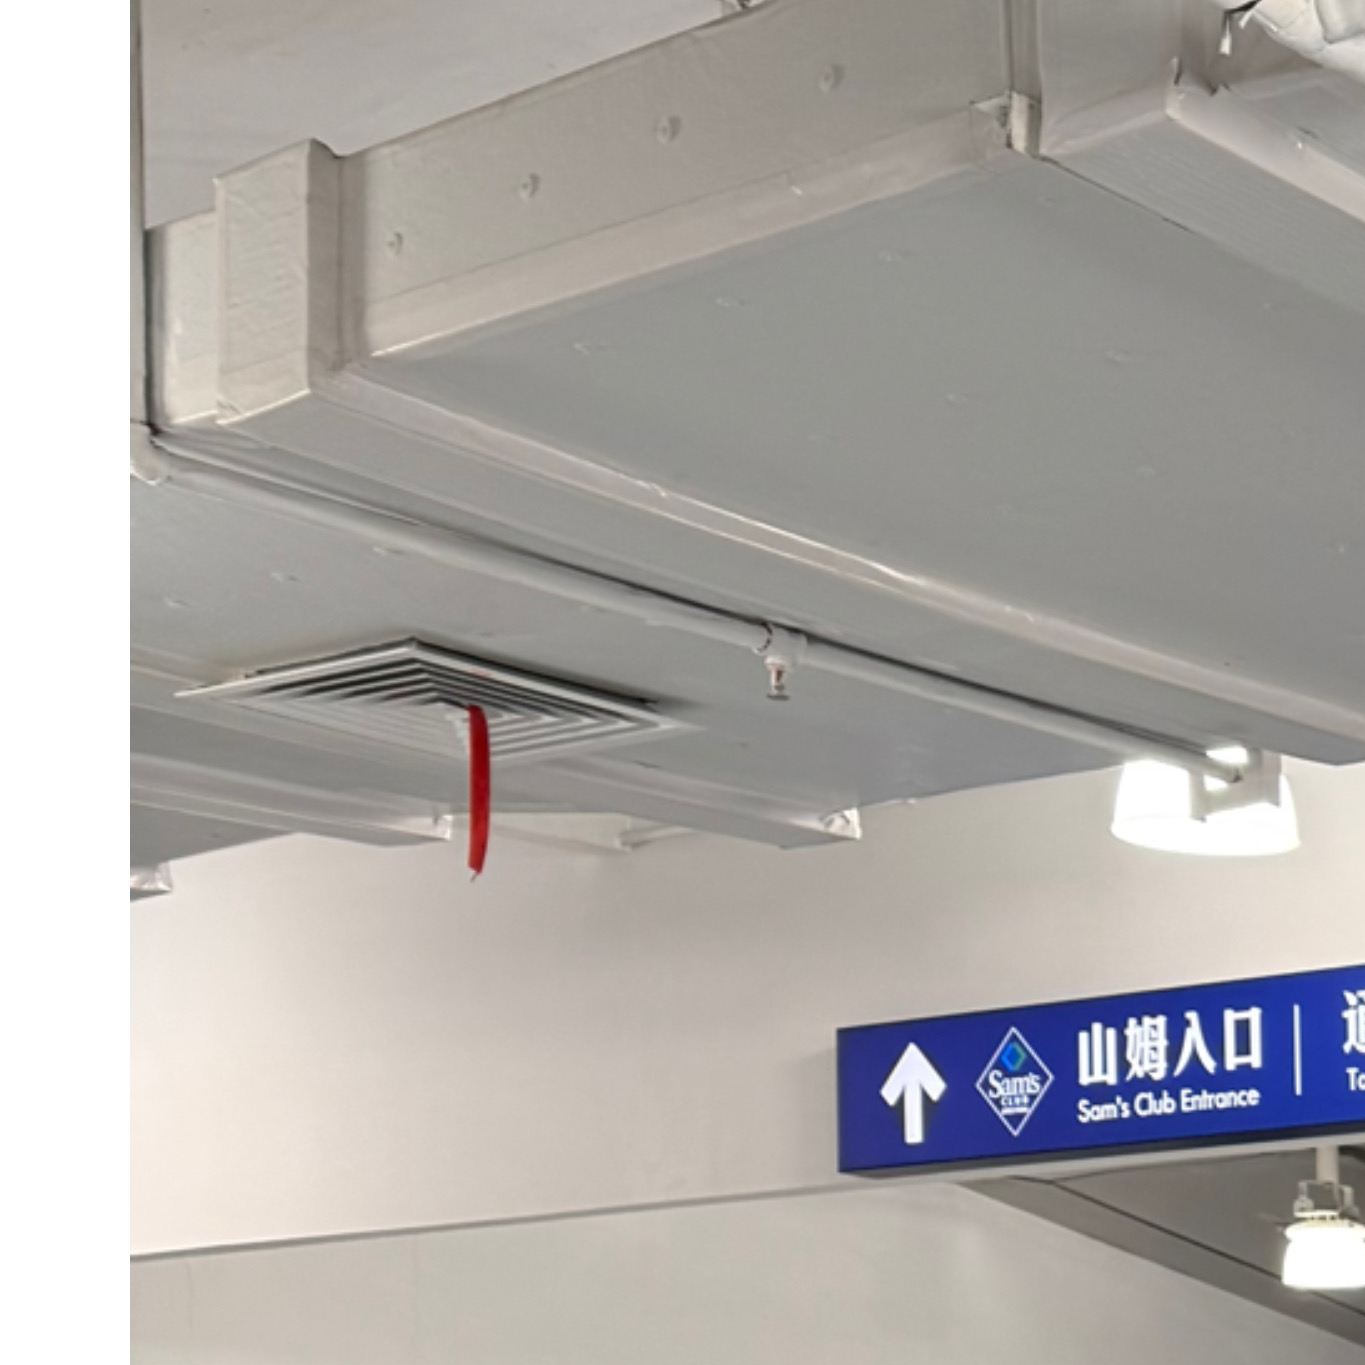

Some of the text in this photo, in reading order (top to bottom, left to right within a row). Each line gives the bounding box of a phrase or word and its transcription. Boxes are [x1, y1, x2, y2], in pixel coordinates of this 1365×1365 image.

[1078, 1006, 1262, 1086] 山姆入口
[988, 1069, 1041, 1098] Sam's
[1077, 1088, 1261, 1123] Sam's Club Entrance
